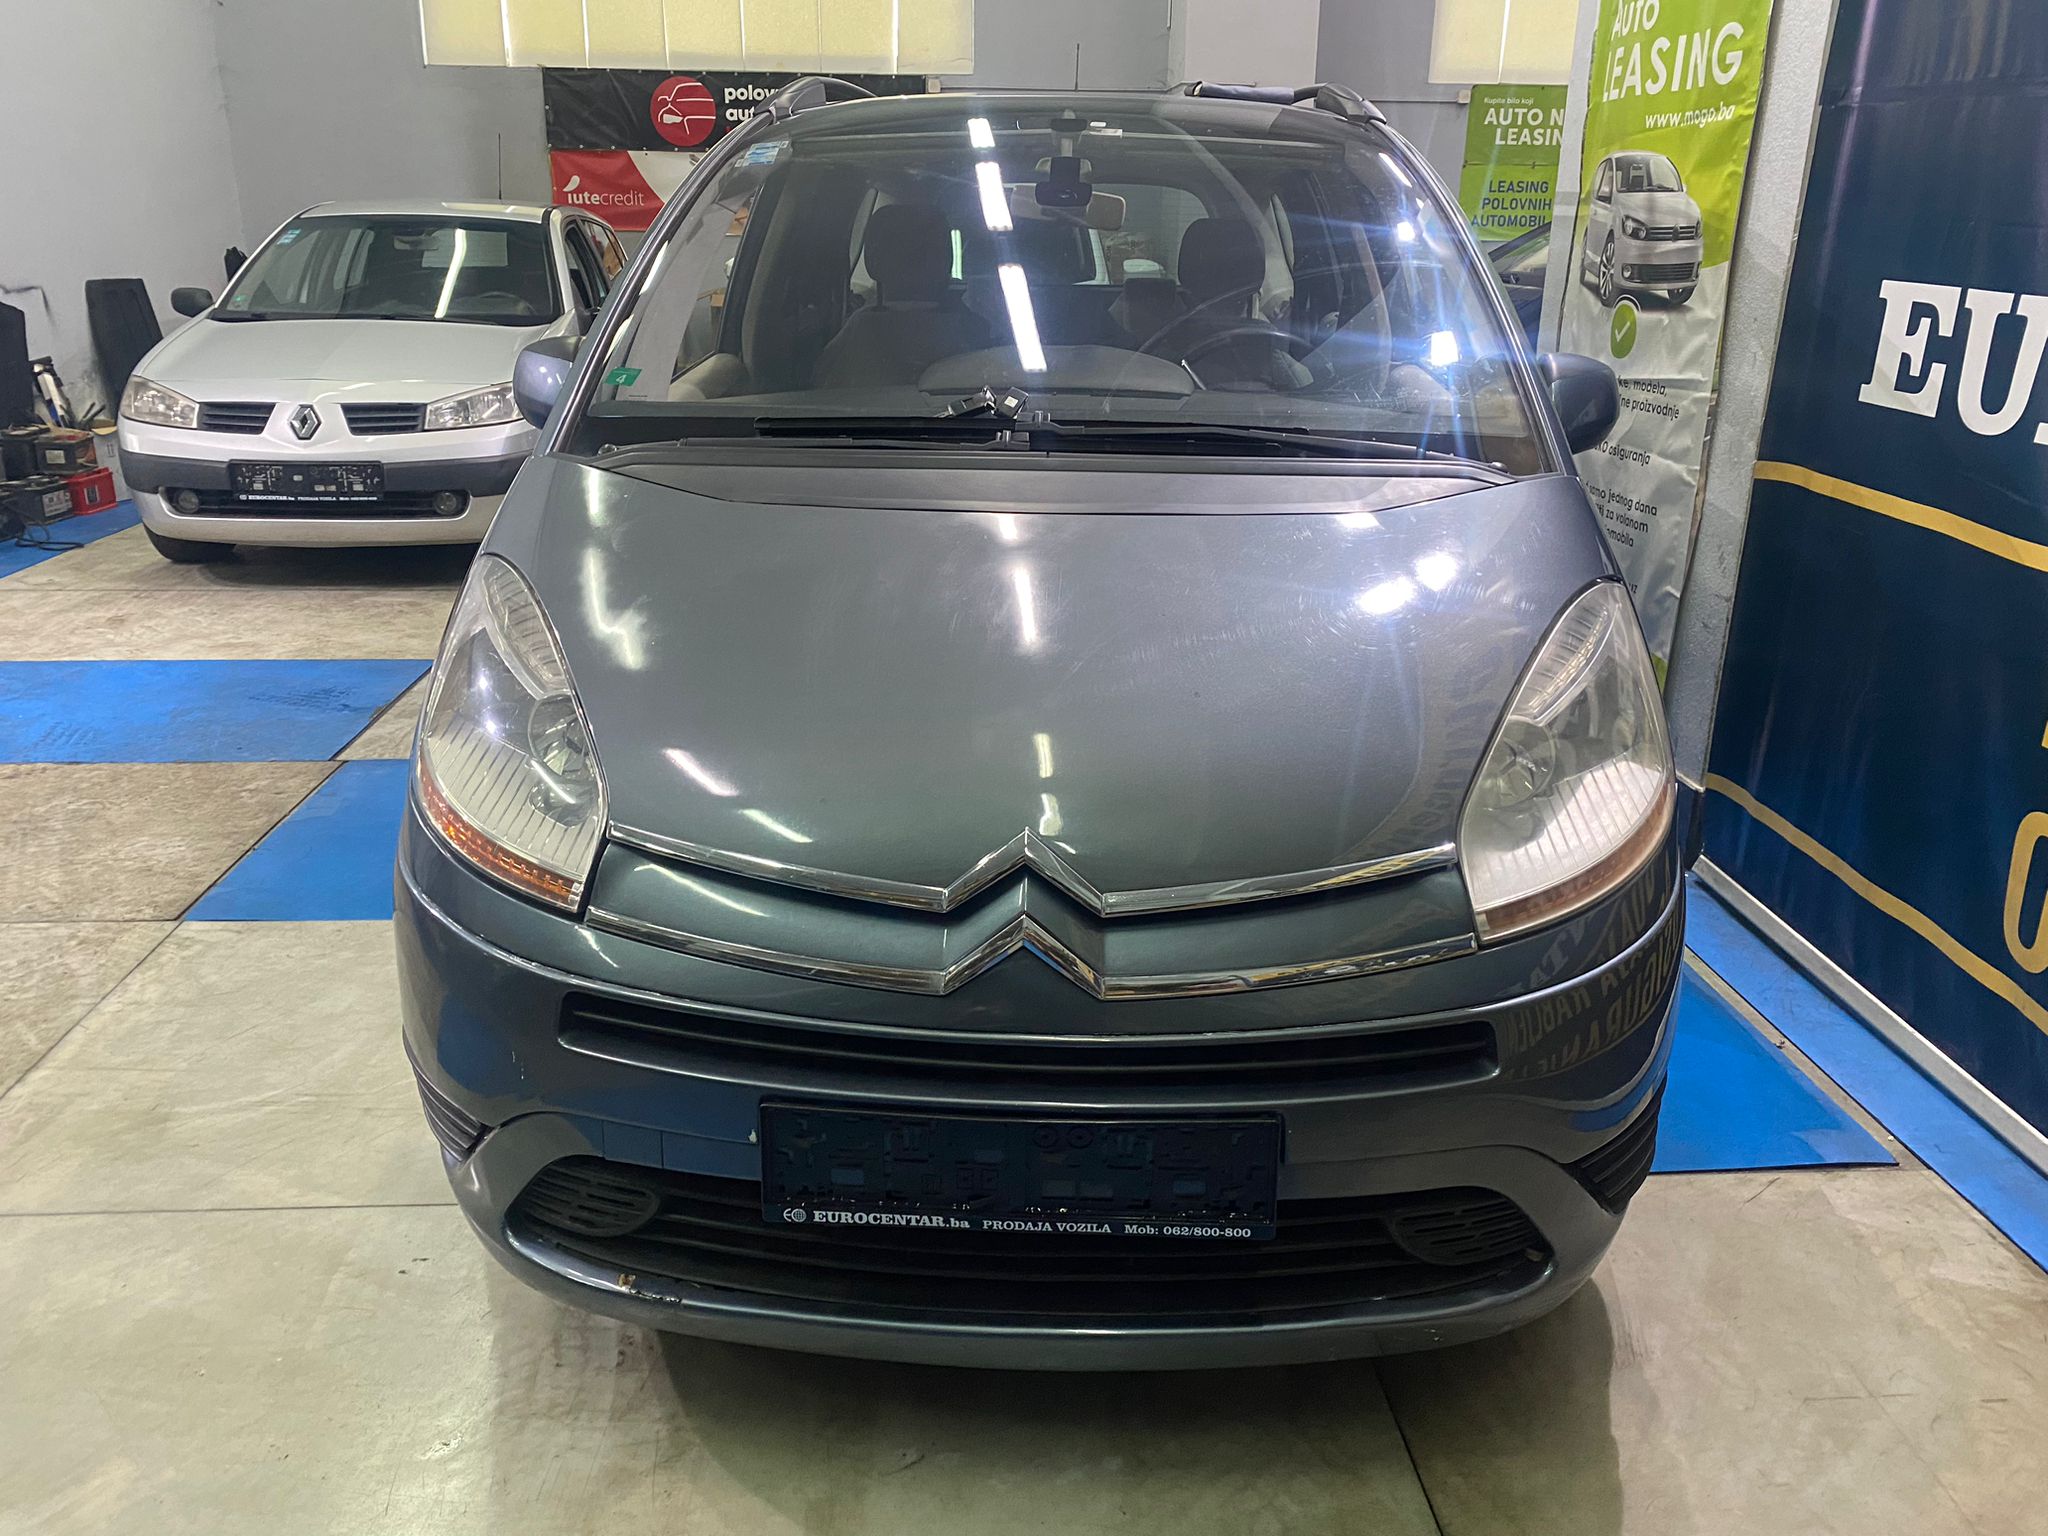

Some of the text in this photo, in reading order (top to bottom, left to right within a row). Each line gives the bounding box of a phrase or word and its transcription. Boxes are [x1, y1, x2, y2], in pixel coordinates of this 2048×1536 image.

[1611, 0, 1660, 41] AUTO
[1602, 21, 1744, 102] LEASING
[724, 84, 779, 103] polov
[725, 105, 755, 121] aut
[1484, 107, 1564, 126] AUTO N
[1645, 101, 1736, 128] www.mogo.ba
[1495, 127, 1563, 146] LEASIN
[563, 175, 645, 206] iutecredit
[1489, 180, 1549, 193] LEASING
[1481, 197, 1553, 211] POLOVNIH
[1471, 214, 1546, 228] AUTOMOBIL
[1633, 381, 1667, 397] modela,
[1631, 400, 1680, 421] proizvodnje
[1608, 445, 1651, 466] osiguranja
[1607, 489, 1633, 511] jednog
[1634, 500, 1657, 516] dana
[1616, 512, 1649, 533] volanom
[813, 1210, 1251, 1238] EUROCENTAR.ba PRODAJA VOZILA Mob: 062/800-800
